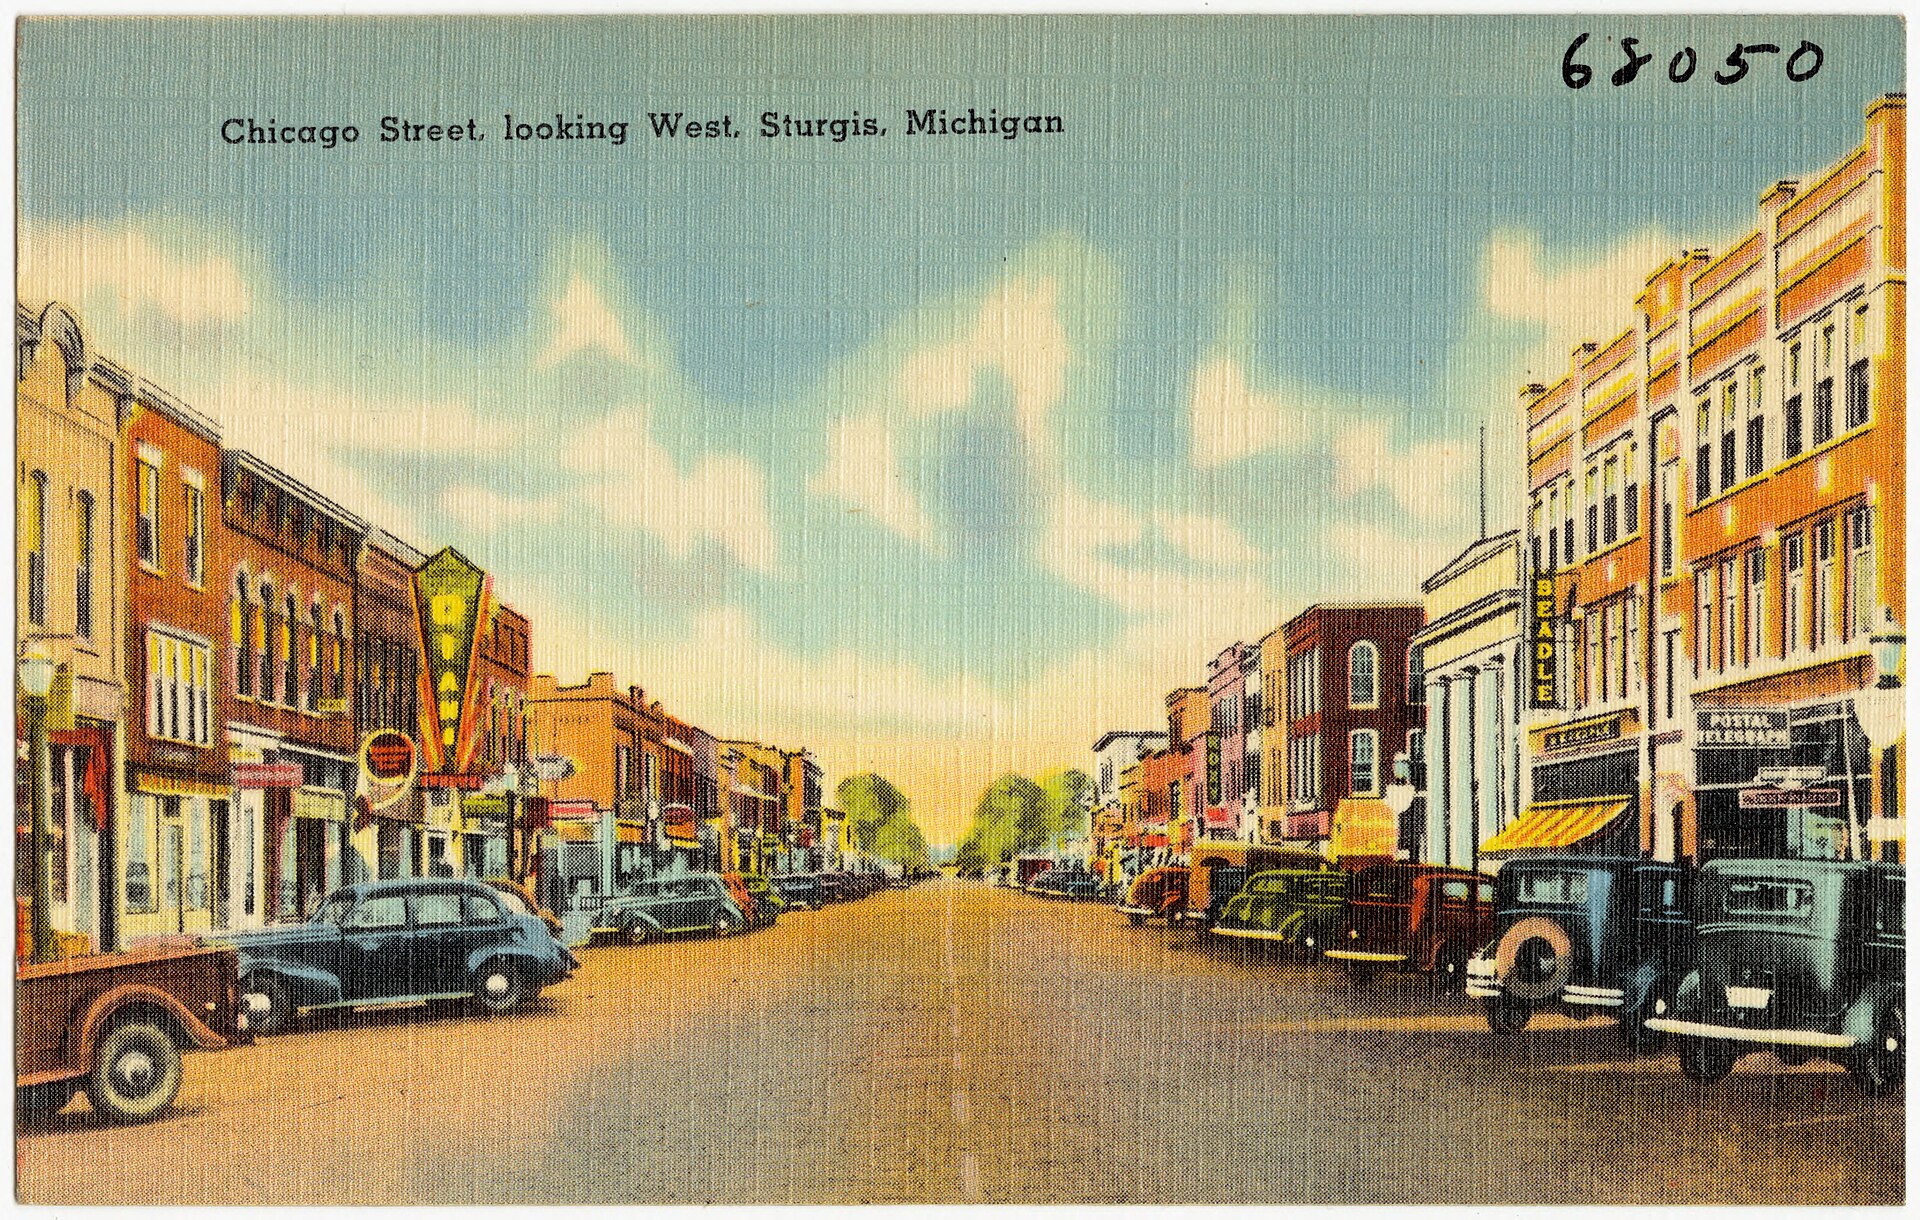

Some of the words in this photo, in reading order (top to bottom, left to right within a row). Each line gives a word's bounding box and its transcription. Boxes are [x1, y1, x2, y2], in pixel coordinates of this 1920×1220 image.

[1562, 32, 1824, 90] 68050
[1537, 579, 1553, 701] BEADLE
[1698, 730, 1788, 744] TELEGRAPH
[1710, 714, 1772, 728] POSTAL
